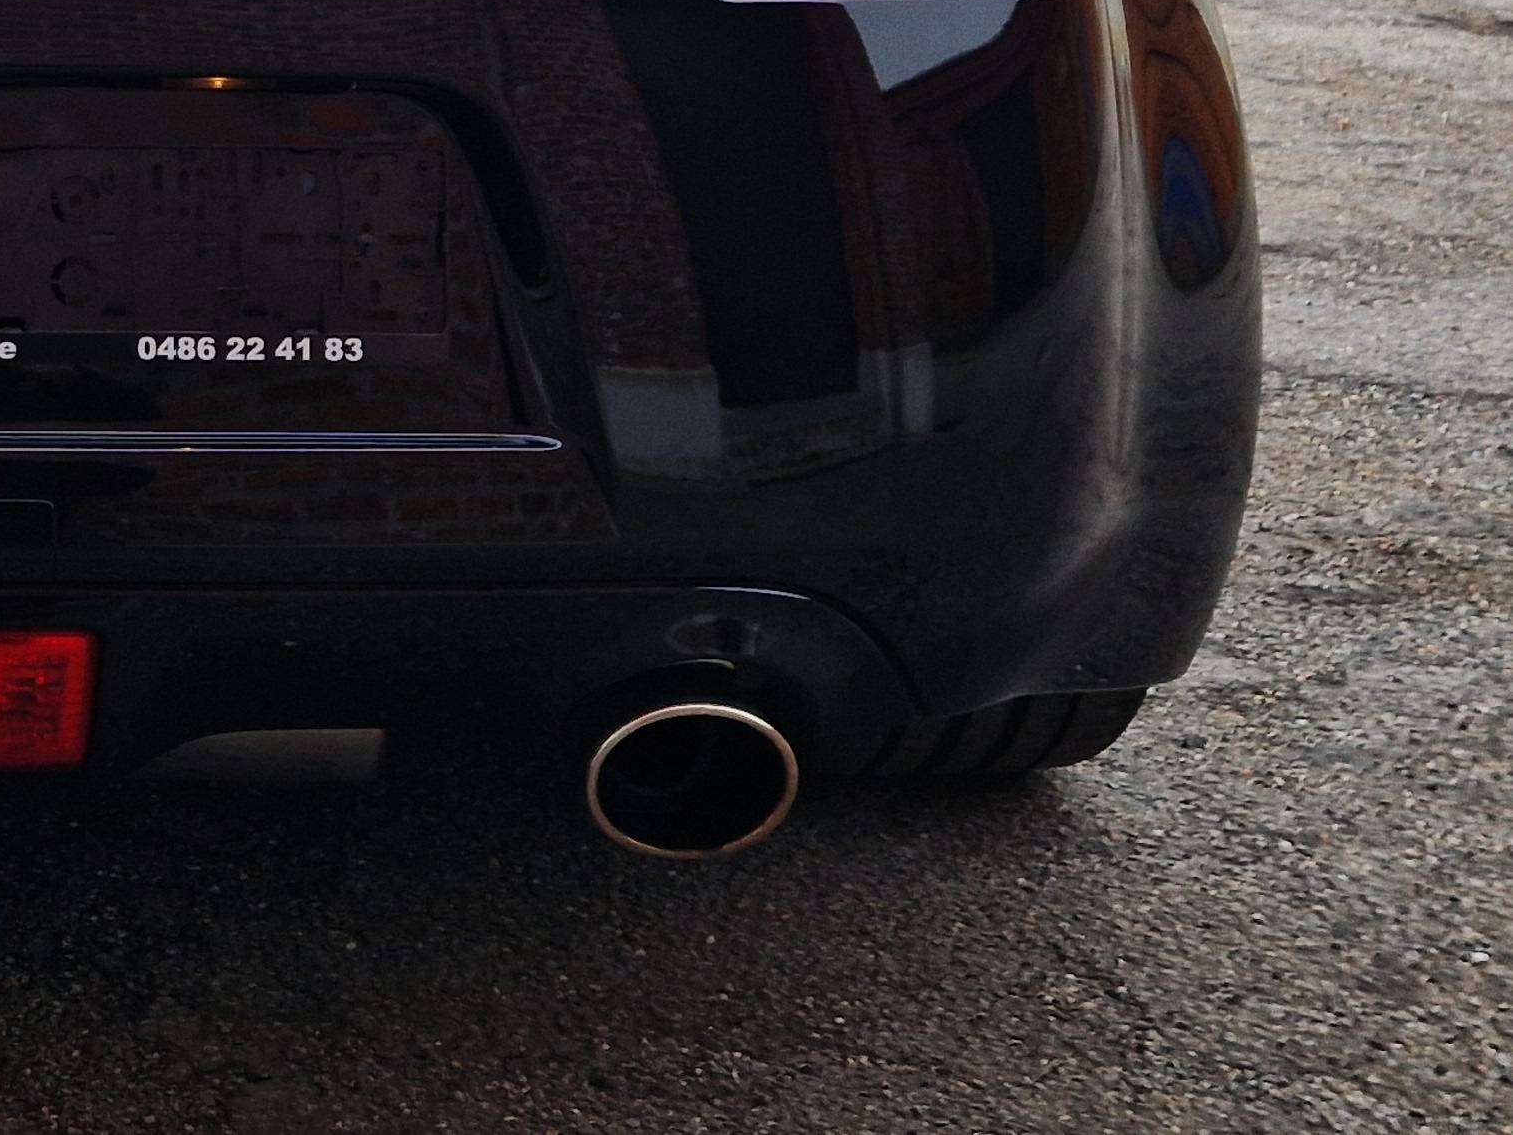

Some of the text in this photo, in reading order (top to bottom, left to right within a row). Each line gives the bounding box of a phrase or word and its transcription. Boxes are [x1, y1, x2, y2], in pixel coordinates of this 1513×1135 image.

[137, 336, 364, 362] 0486 22 41 83
